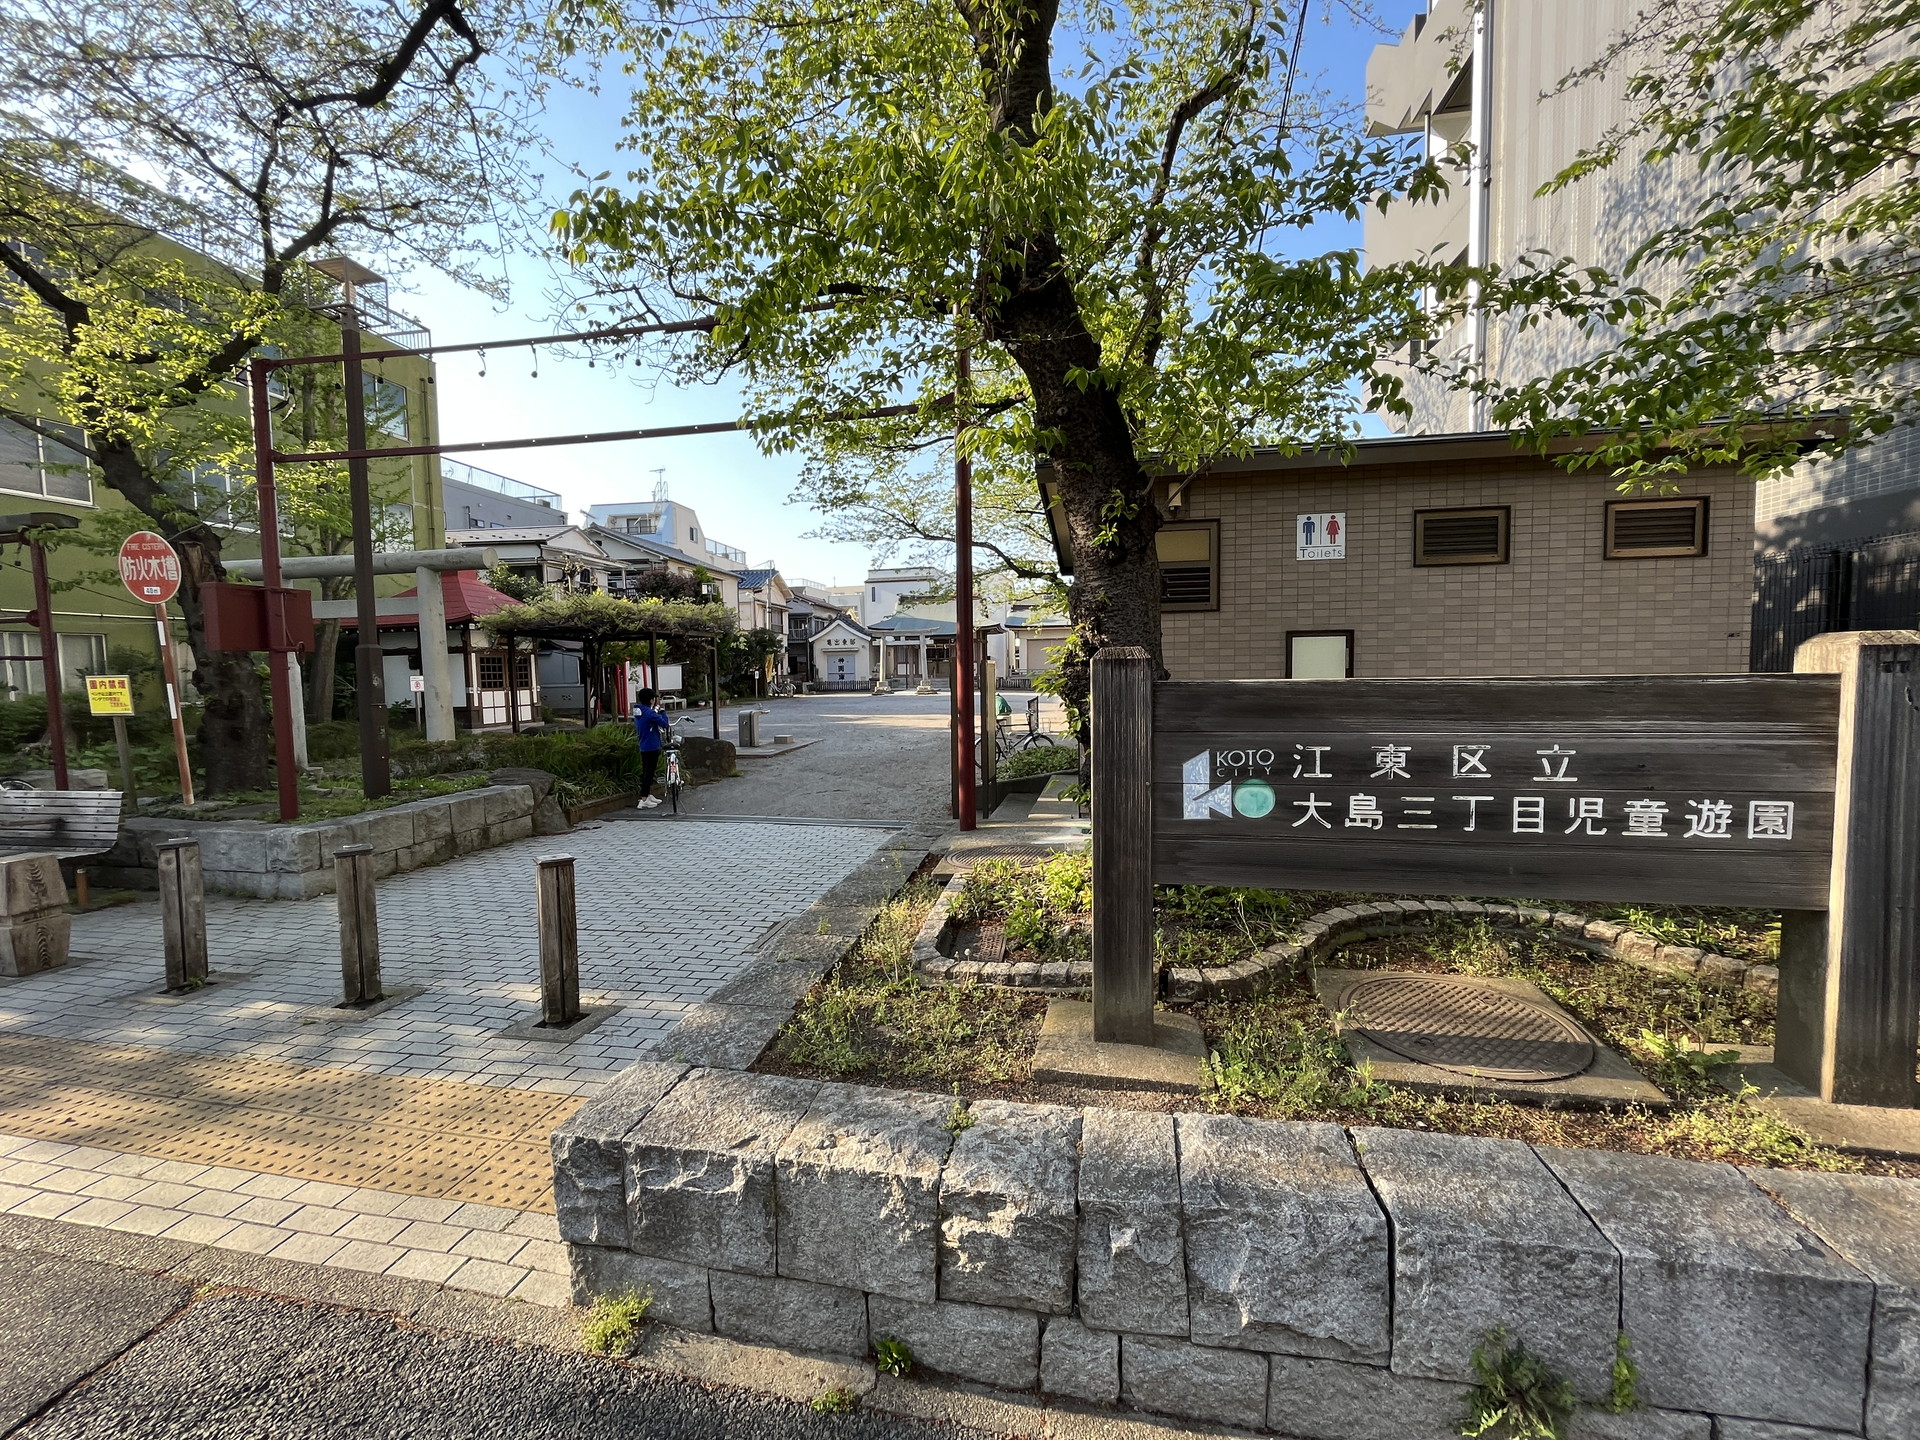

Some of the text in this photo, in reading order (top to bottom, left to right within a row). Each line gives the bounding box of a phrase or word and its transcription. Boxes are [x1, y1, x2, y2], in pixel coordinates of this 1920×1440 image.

[127, 543, 140, 551] FIRE
[1300, 548, 1343, 558] Toilets
[121, 556, 178, 580] 防火水槽
[89, 680, 126, 689] 園内禁煙
[1216, 749, 1275, 767] KOTO
[1293, 743, 1578, 782] 江東区立
[1216, 766, 1272, 777] CITY
[1291, 792, 1795, 840] 大島三丁目児童遊園
